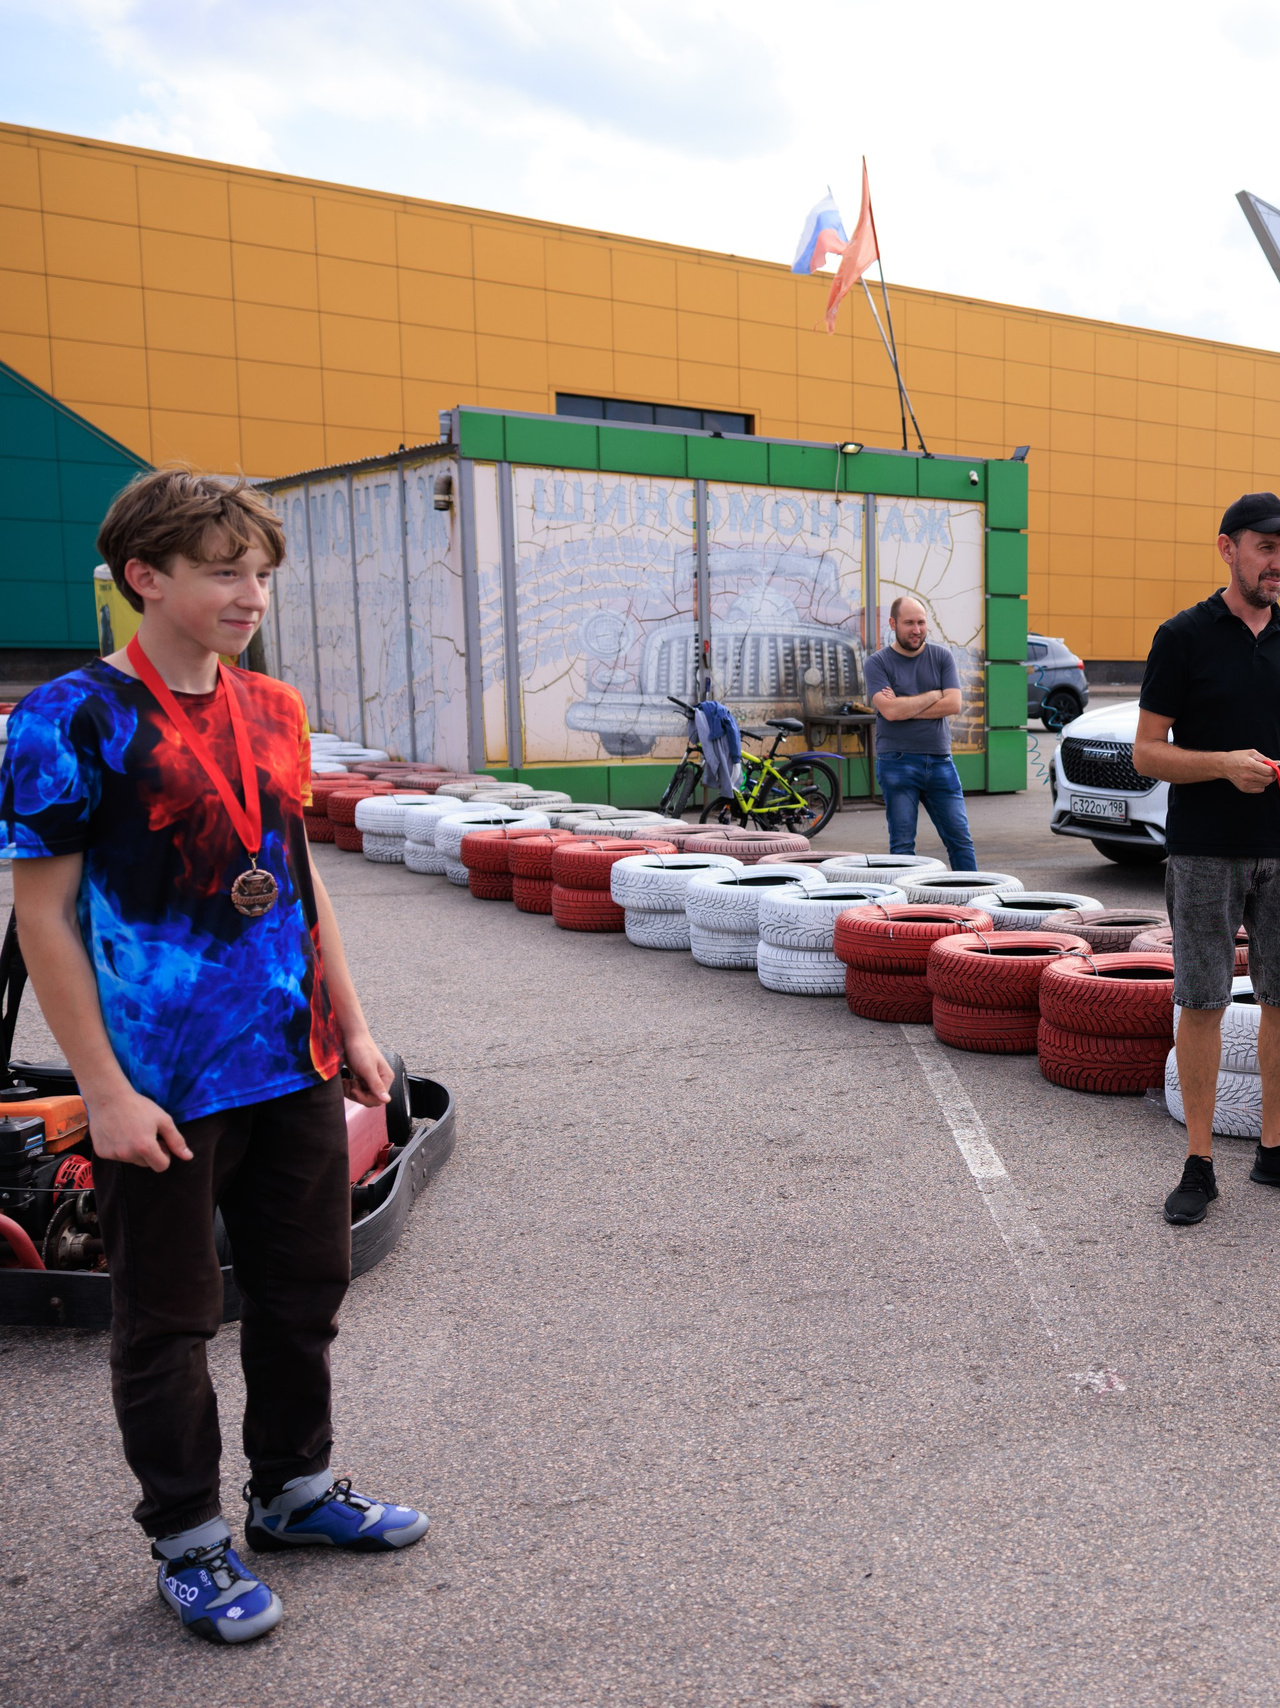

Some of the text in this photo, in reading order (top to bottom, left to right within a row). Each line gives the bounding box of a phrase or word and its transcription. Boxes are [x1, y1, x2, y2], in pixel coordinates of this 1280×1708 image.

[533, 478, 951, 546] ШИНОМОНТАЖ
[1085, 751, 1113, 760] HAVAL
[1109, 801, 1124, 813] 198
